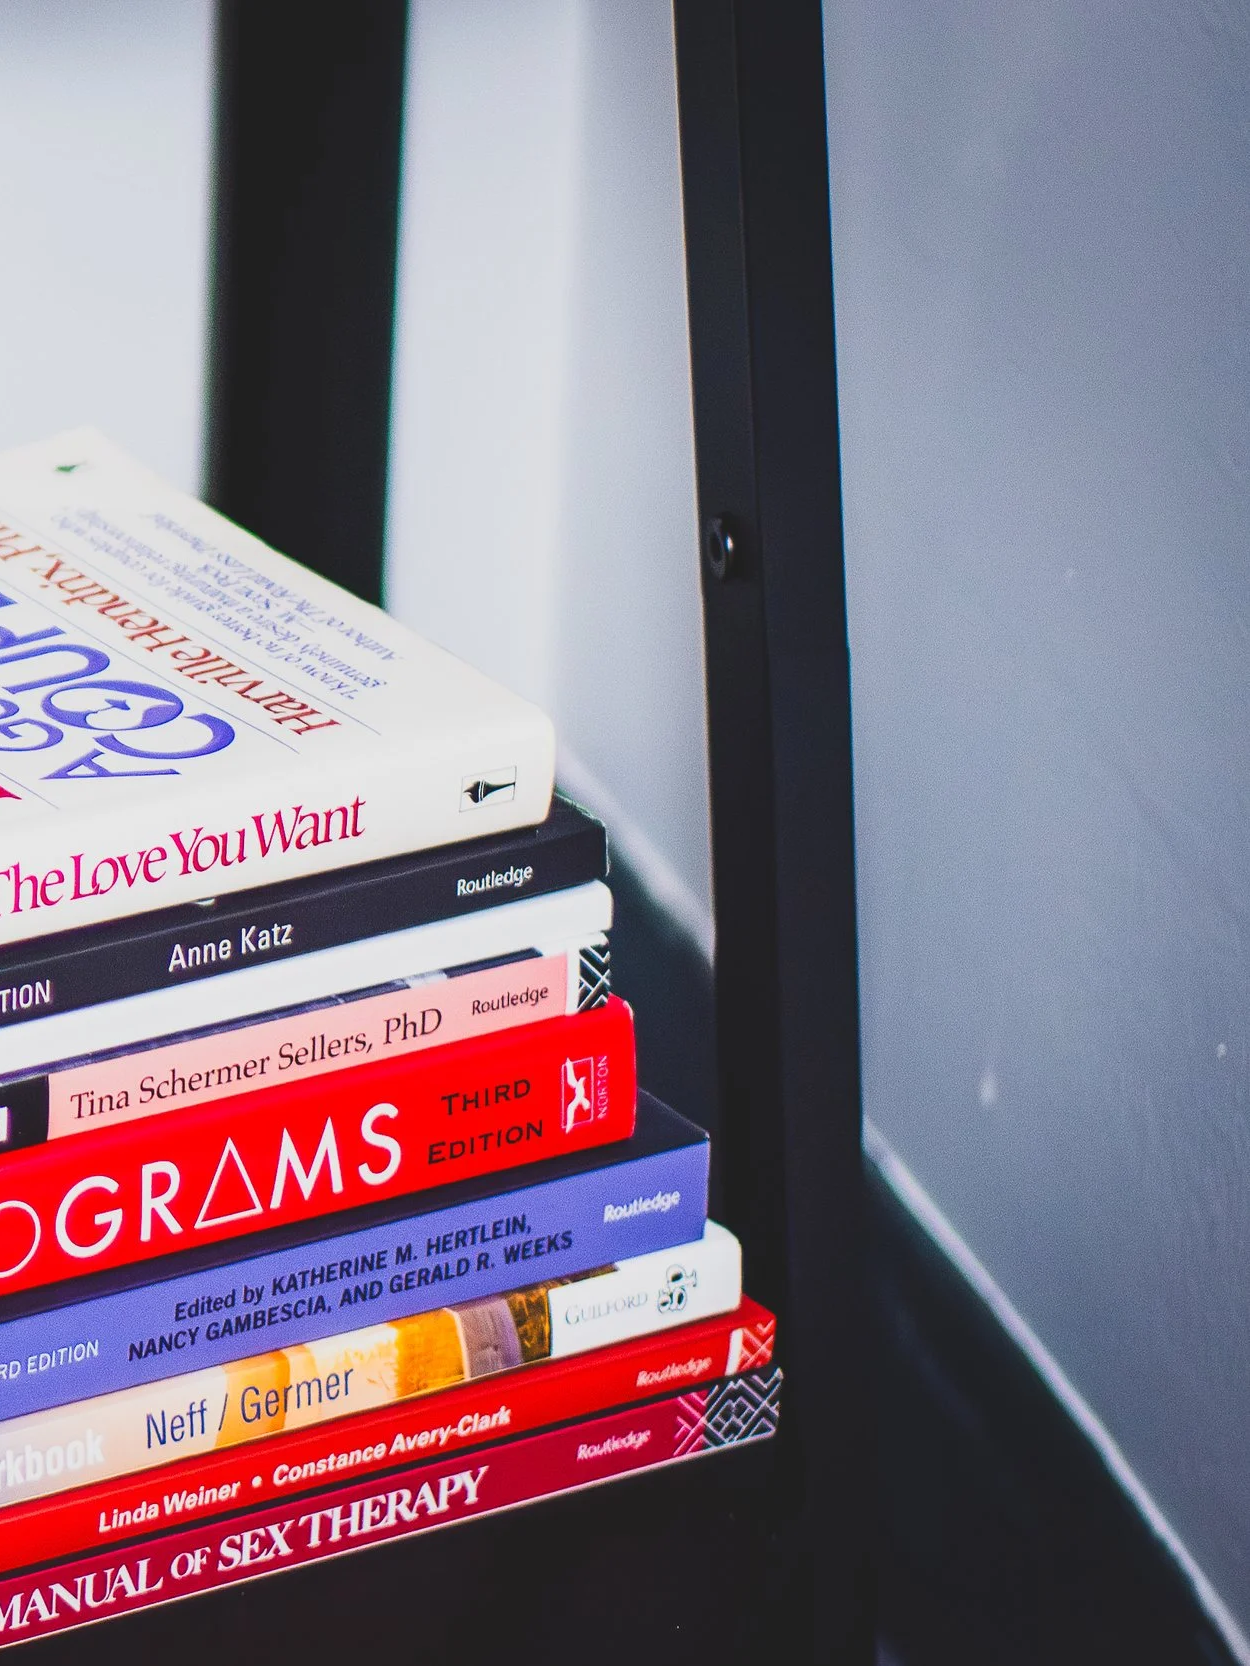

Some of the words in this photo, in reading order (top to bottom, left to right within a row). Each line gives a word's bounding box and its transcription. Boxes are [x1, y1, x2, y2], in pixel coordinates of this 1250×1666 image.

[172, 634, 343, 737] Harville
[37, 748, 181, 782] A
[69, 841, 168, 903] Love
[168, 825, 248, 876] You
[251, 794, 367, 857] Want
[456, 863, 534, 897] Routledge
[168, 936, 232, 973] Anne
[240, 921, 293, 957] Katz
[471, 983, 550, 1017] Routledge
[70, 1084, 130, 1121] Tina
[138, 1052, 271, 1103] Schermer
[277, 1031, 375, 1072] Sellers,
[383, 1007, 443, 1046] PhD
[597, 1054, 609, 1120] NORTON
[440, 1078, 533, 1117] THIRD
[426, 1118, 544, 1166] EDITION
[603, 1189, 681, 1224] Routledge
[174, 1290, 237, 1322] Edited
[242, 1283, 265, 1306] by
[270, 1250, 387, 1297] KATHERINE
[395, 1240, 419, 1264] M.
[426, 1213, 533, 1257] HERTLEIN,
[127, 1328, 198, 1362] NANCY
[205, 1297, 334, 1343] GAMBESCIA,
[338, 1279, 384, 1308] AND
[389, 1262, 468, 1296] GERALD
[476, 1250, 496, 1272] R.
[503, 1230, 575, 1266] WEEKS
[564, 1290, 648, 1326] GUILFORD
[26, 1338, 100, 1374] EDITION
[637, 1355, 713, 1388] Routledge
[146, 1397, 209, 1450] Neff
[240, 1366, 355, 1424] Germer
[577, 1428, 652, 1461] Routledge
[98, 1501, 160, 1535] Linda
[162, 1478, 242, 1517] Weiner
[272, 1442, 387, 1486] Constance
[390, 1405, 512, 1455] Avery-Clark
[170, 1546, 212, 1582] OF
[216, 1518, 297, 1574] SEX
[298, 1464, 490, 1549] THERAPY
